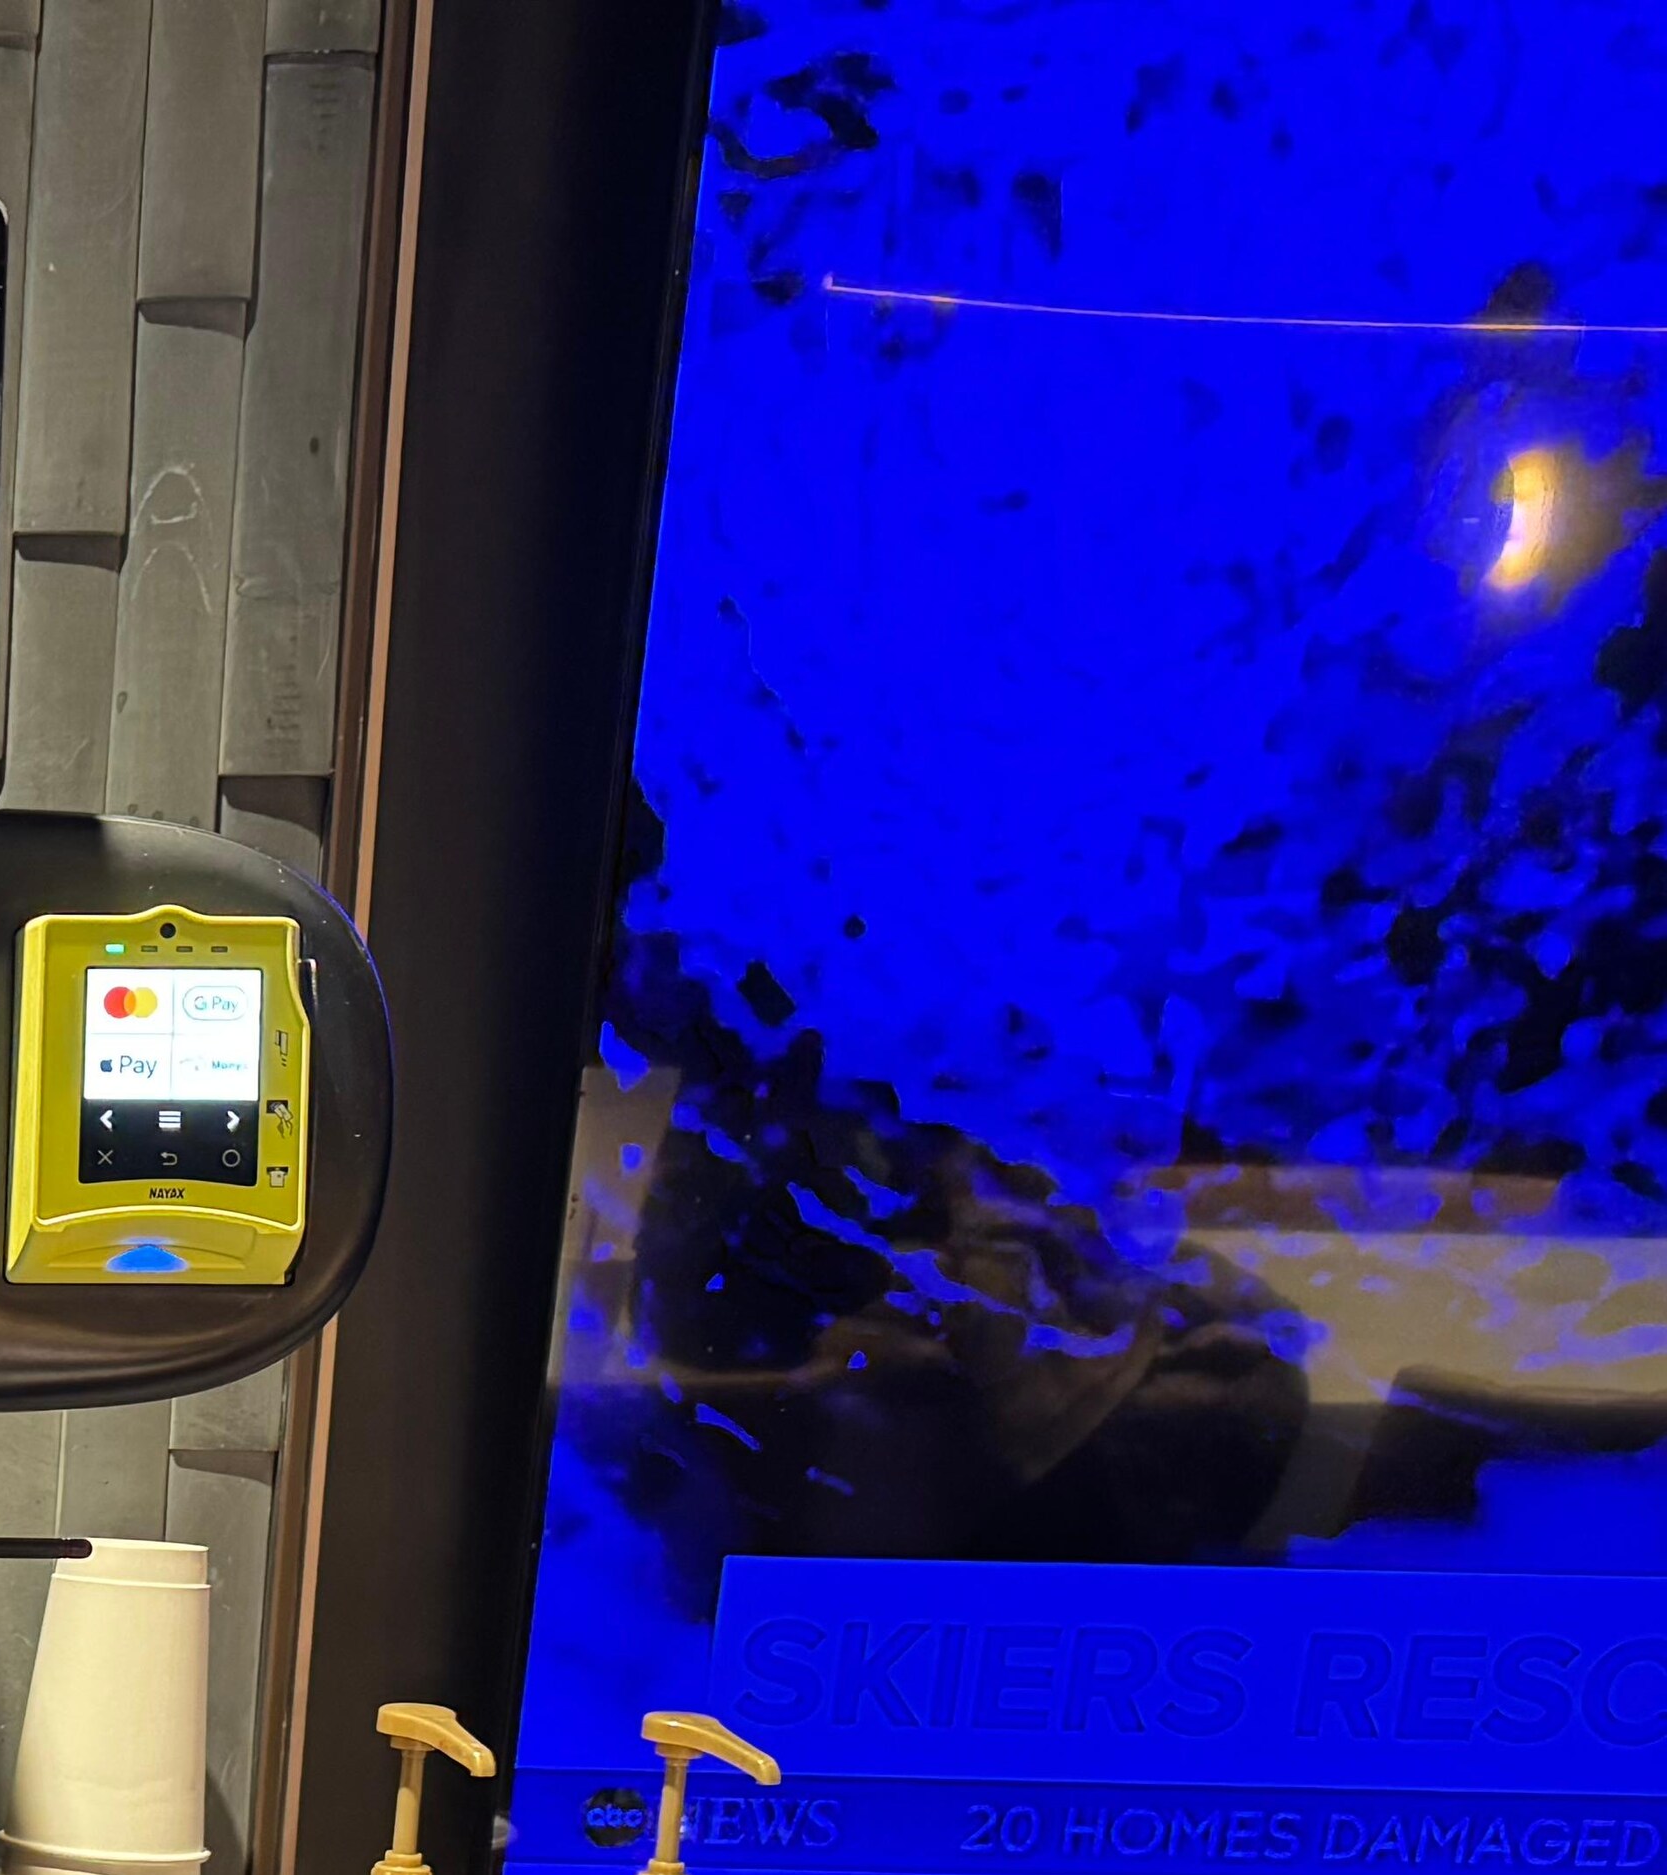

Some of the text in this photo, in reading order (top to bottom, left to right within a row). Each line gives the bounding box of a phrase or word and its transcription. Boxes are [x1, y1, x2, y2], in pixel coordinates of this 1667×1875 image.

[212, 996, 238, 1013] Pay
[120, 1055, 157, 1078] Pay
[149, 1188, 185, 1200] NAYAX
[731, 1617, 1255, 1739] SKIERS
[586, 1805, 642, 1828] abc
[959, 1803, 1661, 1870] 20 HOMES DAMAGED
